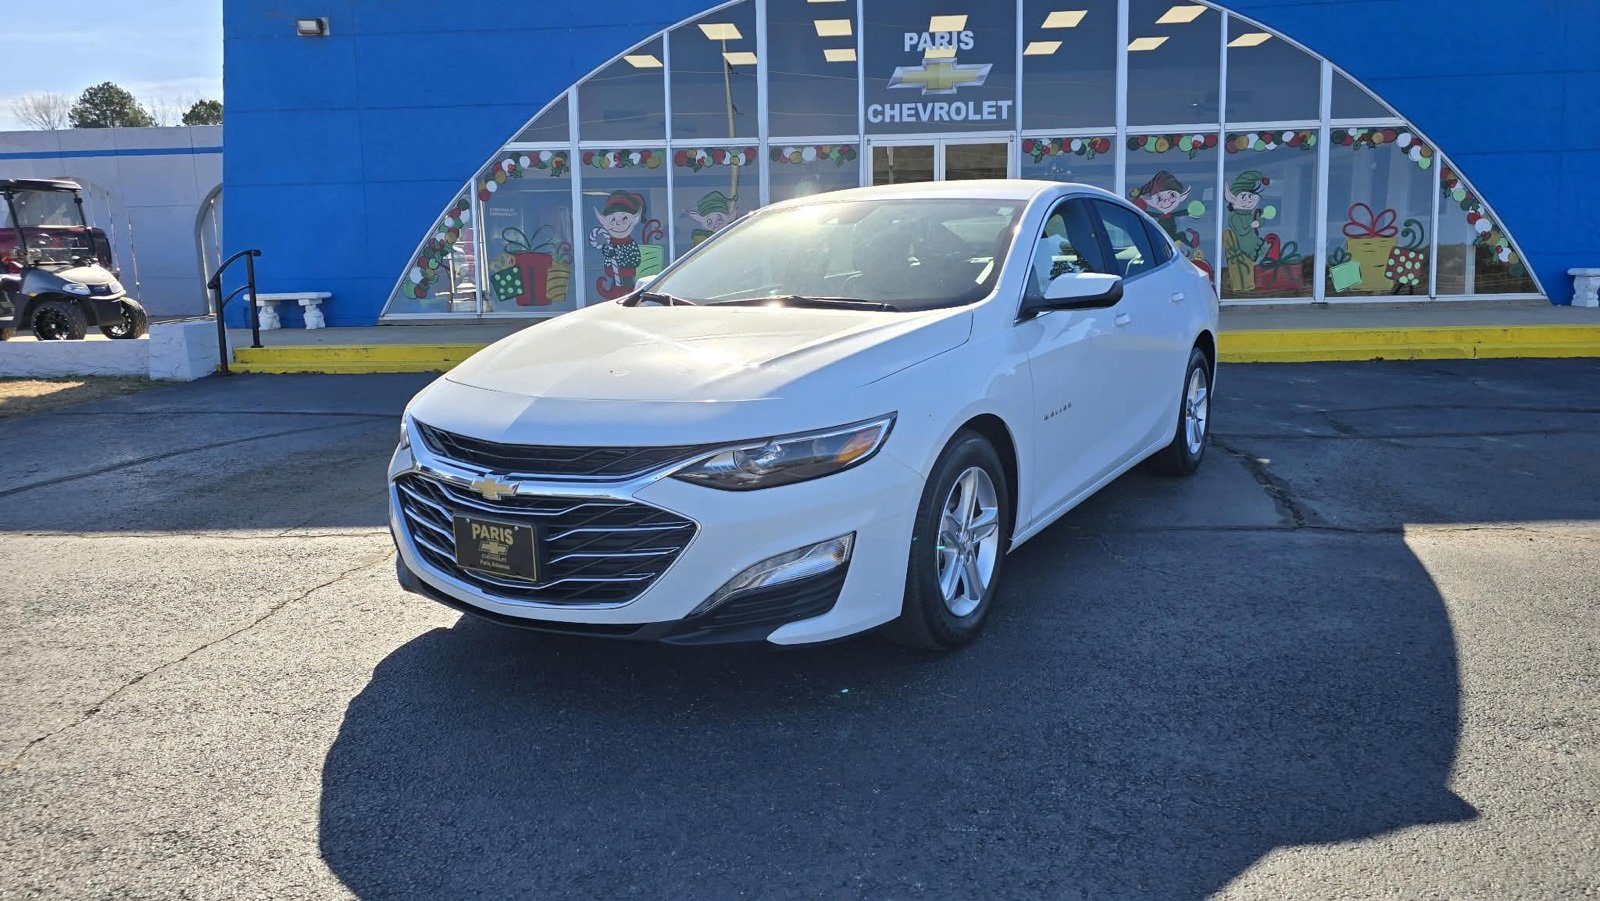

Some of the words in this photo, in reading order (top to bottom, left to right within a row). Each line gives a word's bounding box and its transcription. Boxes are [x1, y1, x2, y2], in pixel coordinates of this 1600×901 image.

[904, 31, 974, 52] PARIS
[867, 100, 1013, 123] CHEVROLET
[471, 523, 514, 546] PARIS
